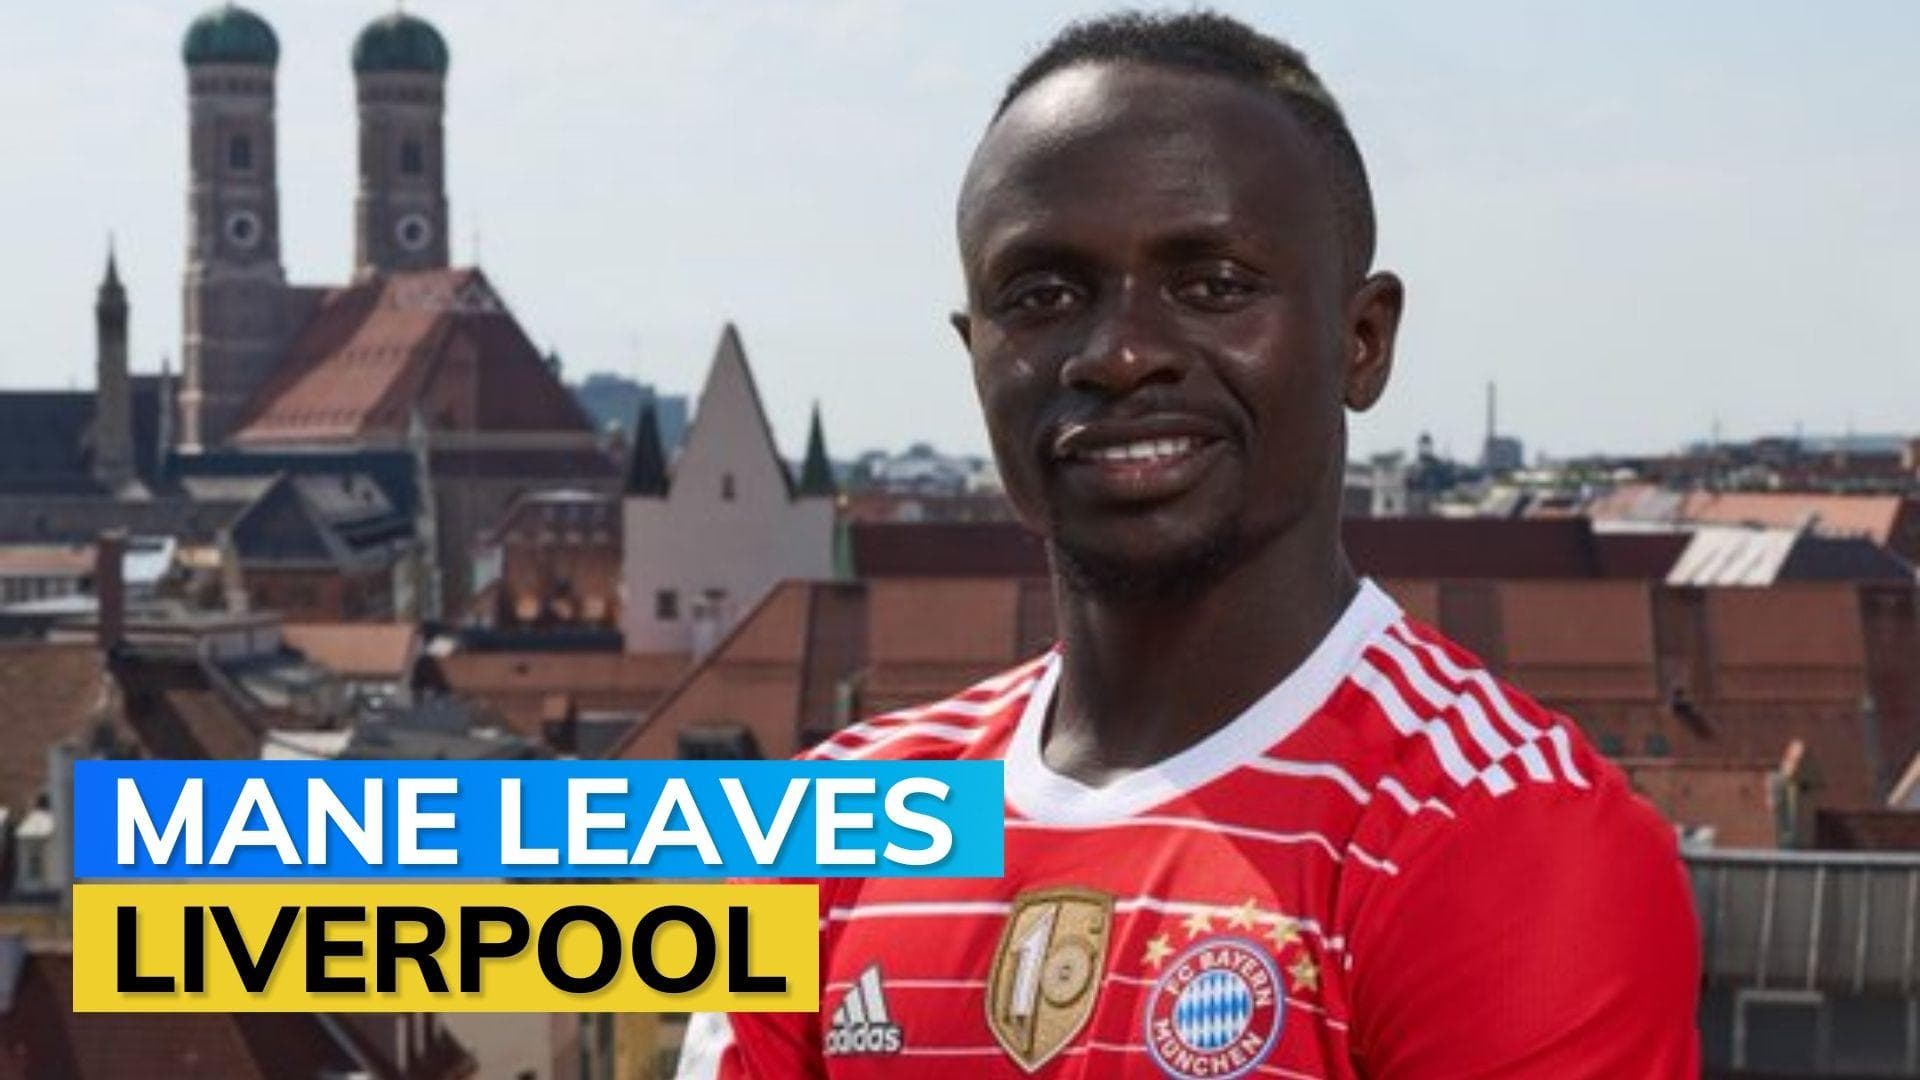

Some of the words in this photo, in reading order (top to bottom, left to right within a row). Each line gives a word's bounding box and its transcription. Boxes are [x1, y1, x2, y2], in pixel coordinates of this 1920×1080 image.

[1165, 964, 1194, 995] FC
[1199, 949, 1272, 1007] BAYERN
[823, 1023, 901, 1055] adidas
